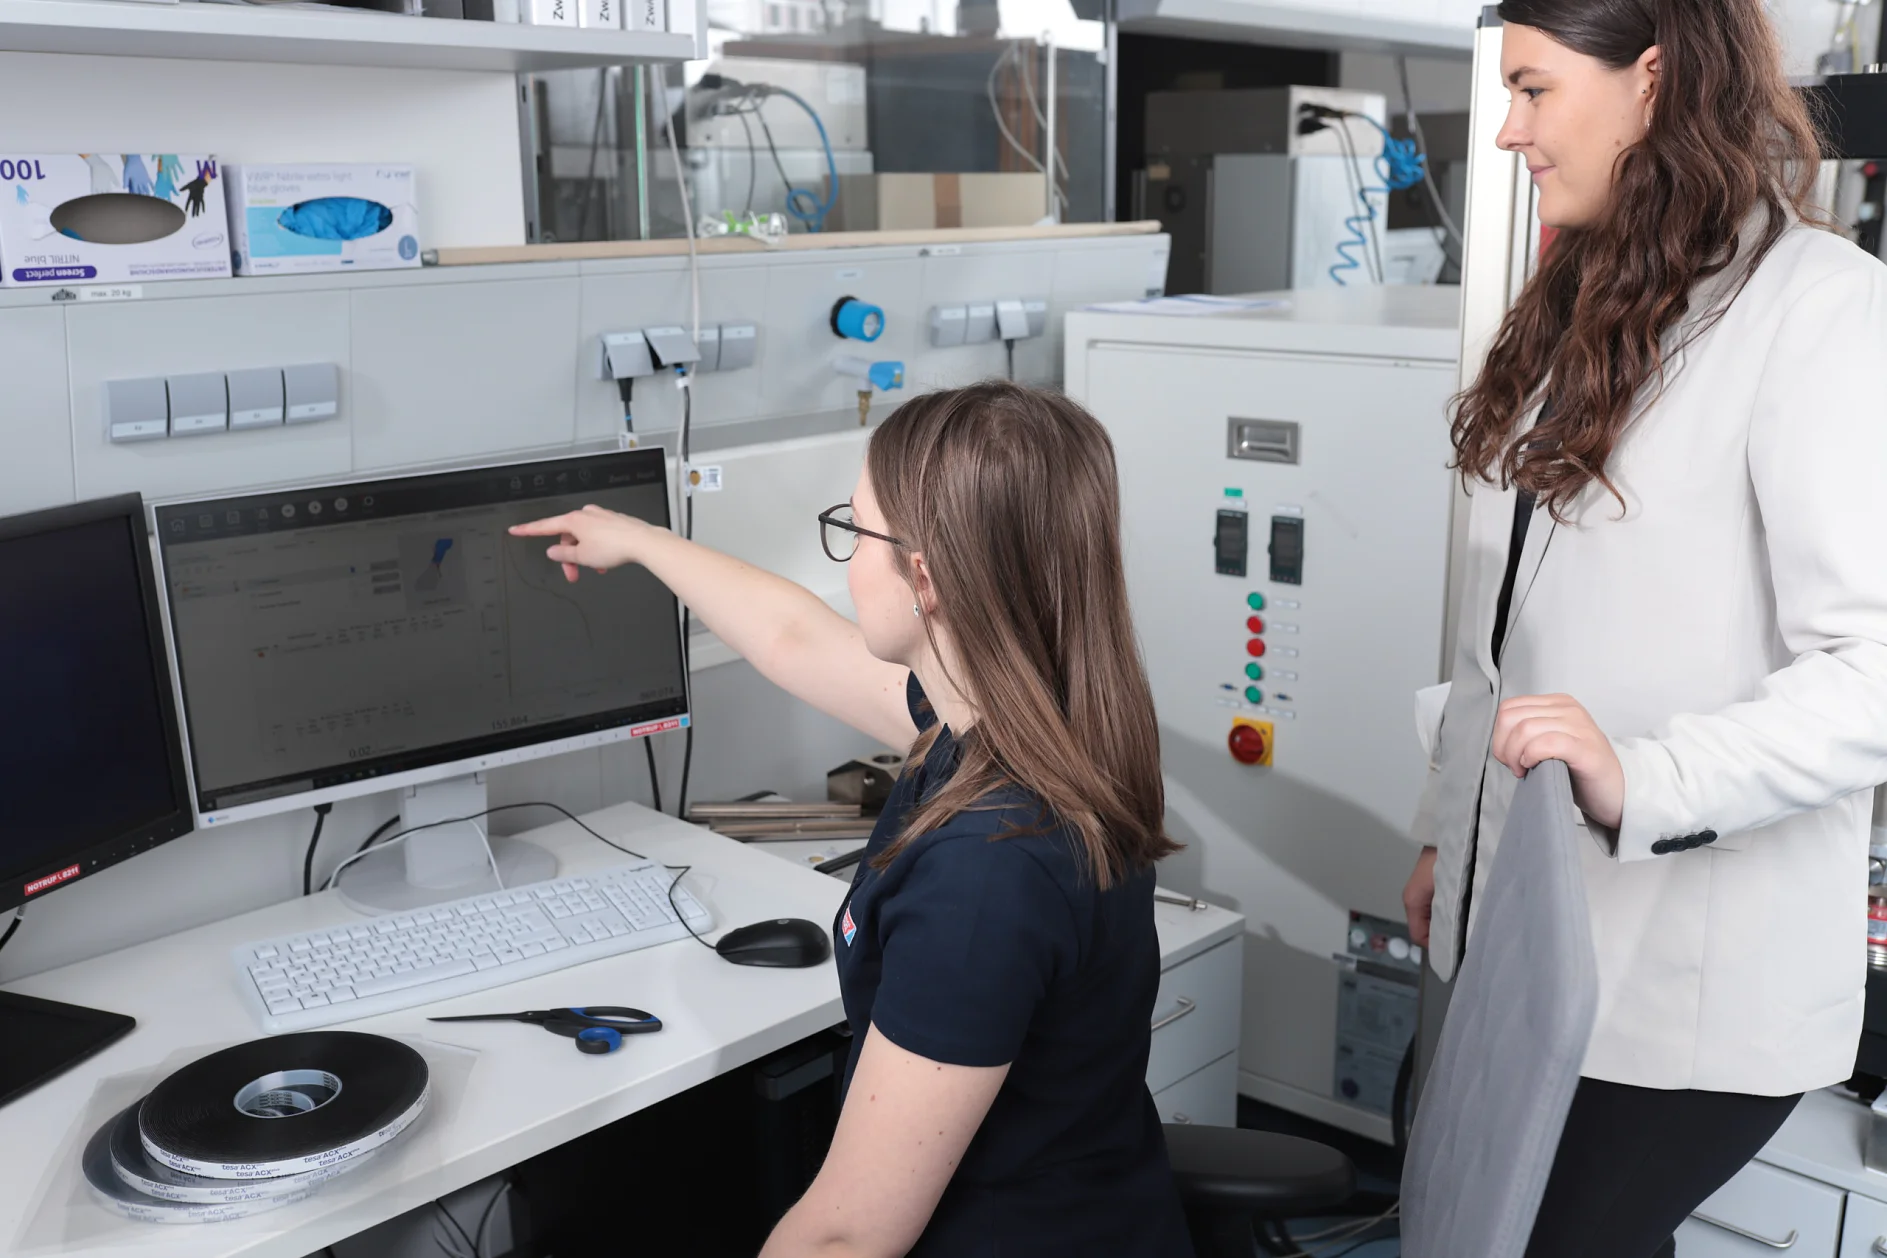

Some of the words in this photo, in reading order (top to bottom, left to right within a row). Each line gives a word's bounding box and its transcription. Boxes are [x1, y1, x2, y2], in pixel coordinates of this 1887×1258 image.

[0, 159, 46, 180] 100
[196, 160, 216, 179] M
[24, 255, 47, 265] blue
[48, 254, 80, 265] NITRIL
[25, 268, 55, 280] perfect
[56, 267, 85, 278] Screen
[111, 289, 120, 297] 20
[27, 875, 57, 892] NOTRUF
[319, 1158, 336, 1166] tesa
